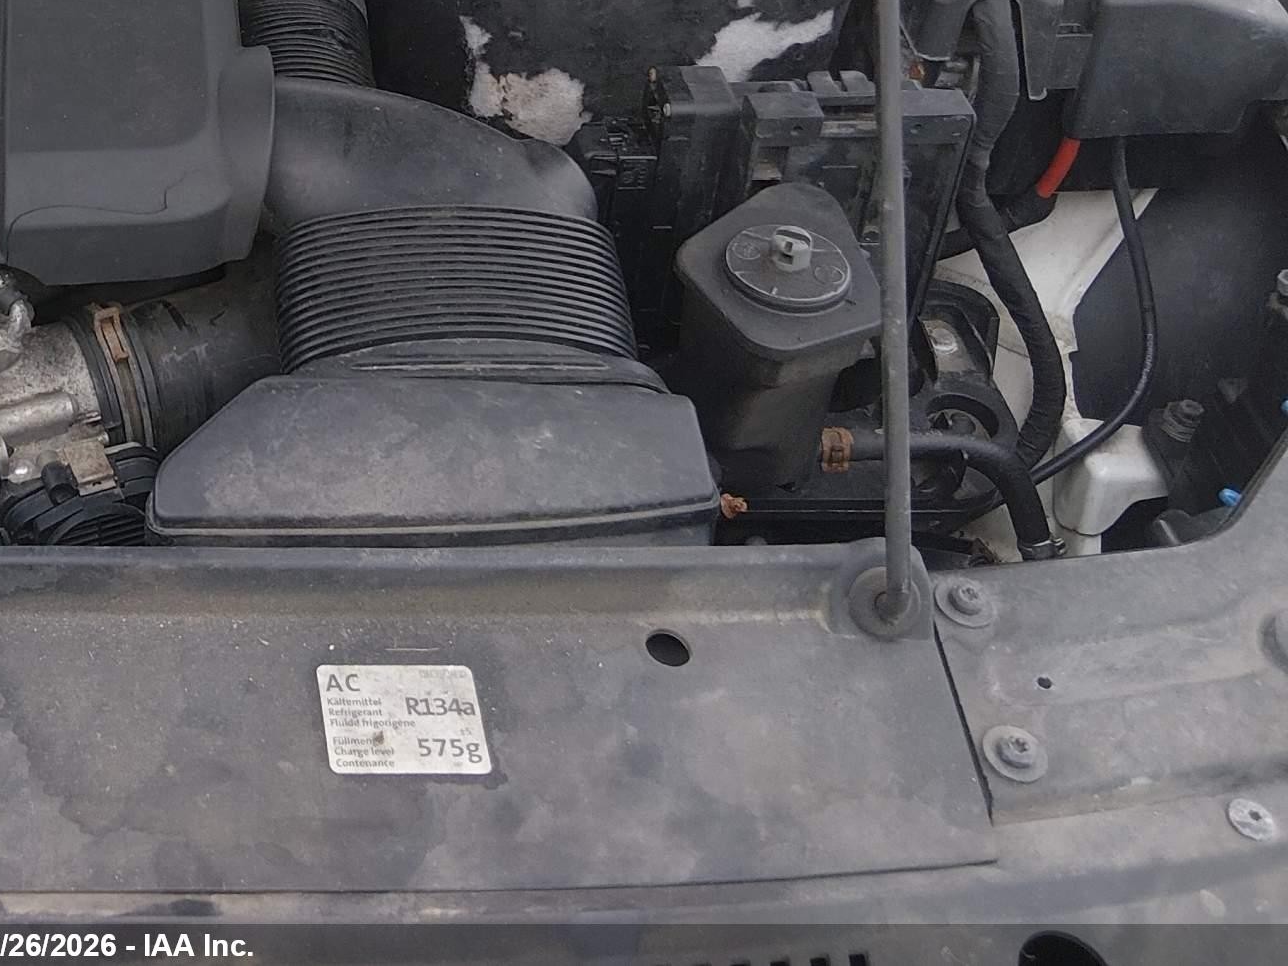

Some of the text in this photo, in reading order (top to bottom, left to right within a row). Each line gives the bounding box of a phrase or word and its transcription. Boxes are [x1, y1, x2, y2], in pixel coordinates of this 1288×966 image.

[325, 673, 361, 692] AC
[327, 697, 382, 706] Kältemittel
[404, 697, 476, 716] R134a
[328, 708, 383, 718] Refrigerant
[330, 719, 360, 727] Fluide
[335, 747, 395, 758] Charge level
[336, 758, 396, 768] Contenance
